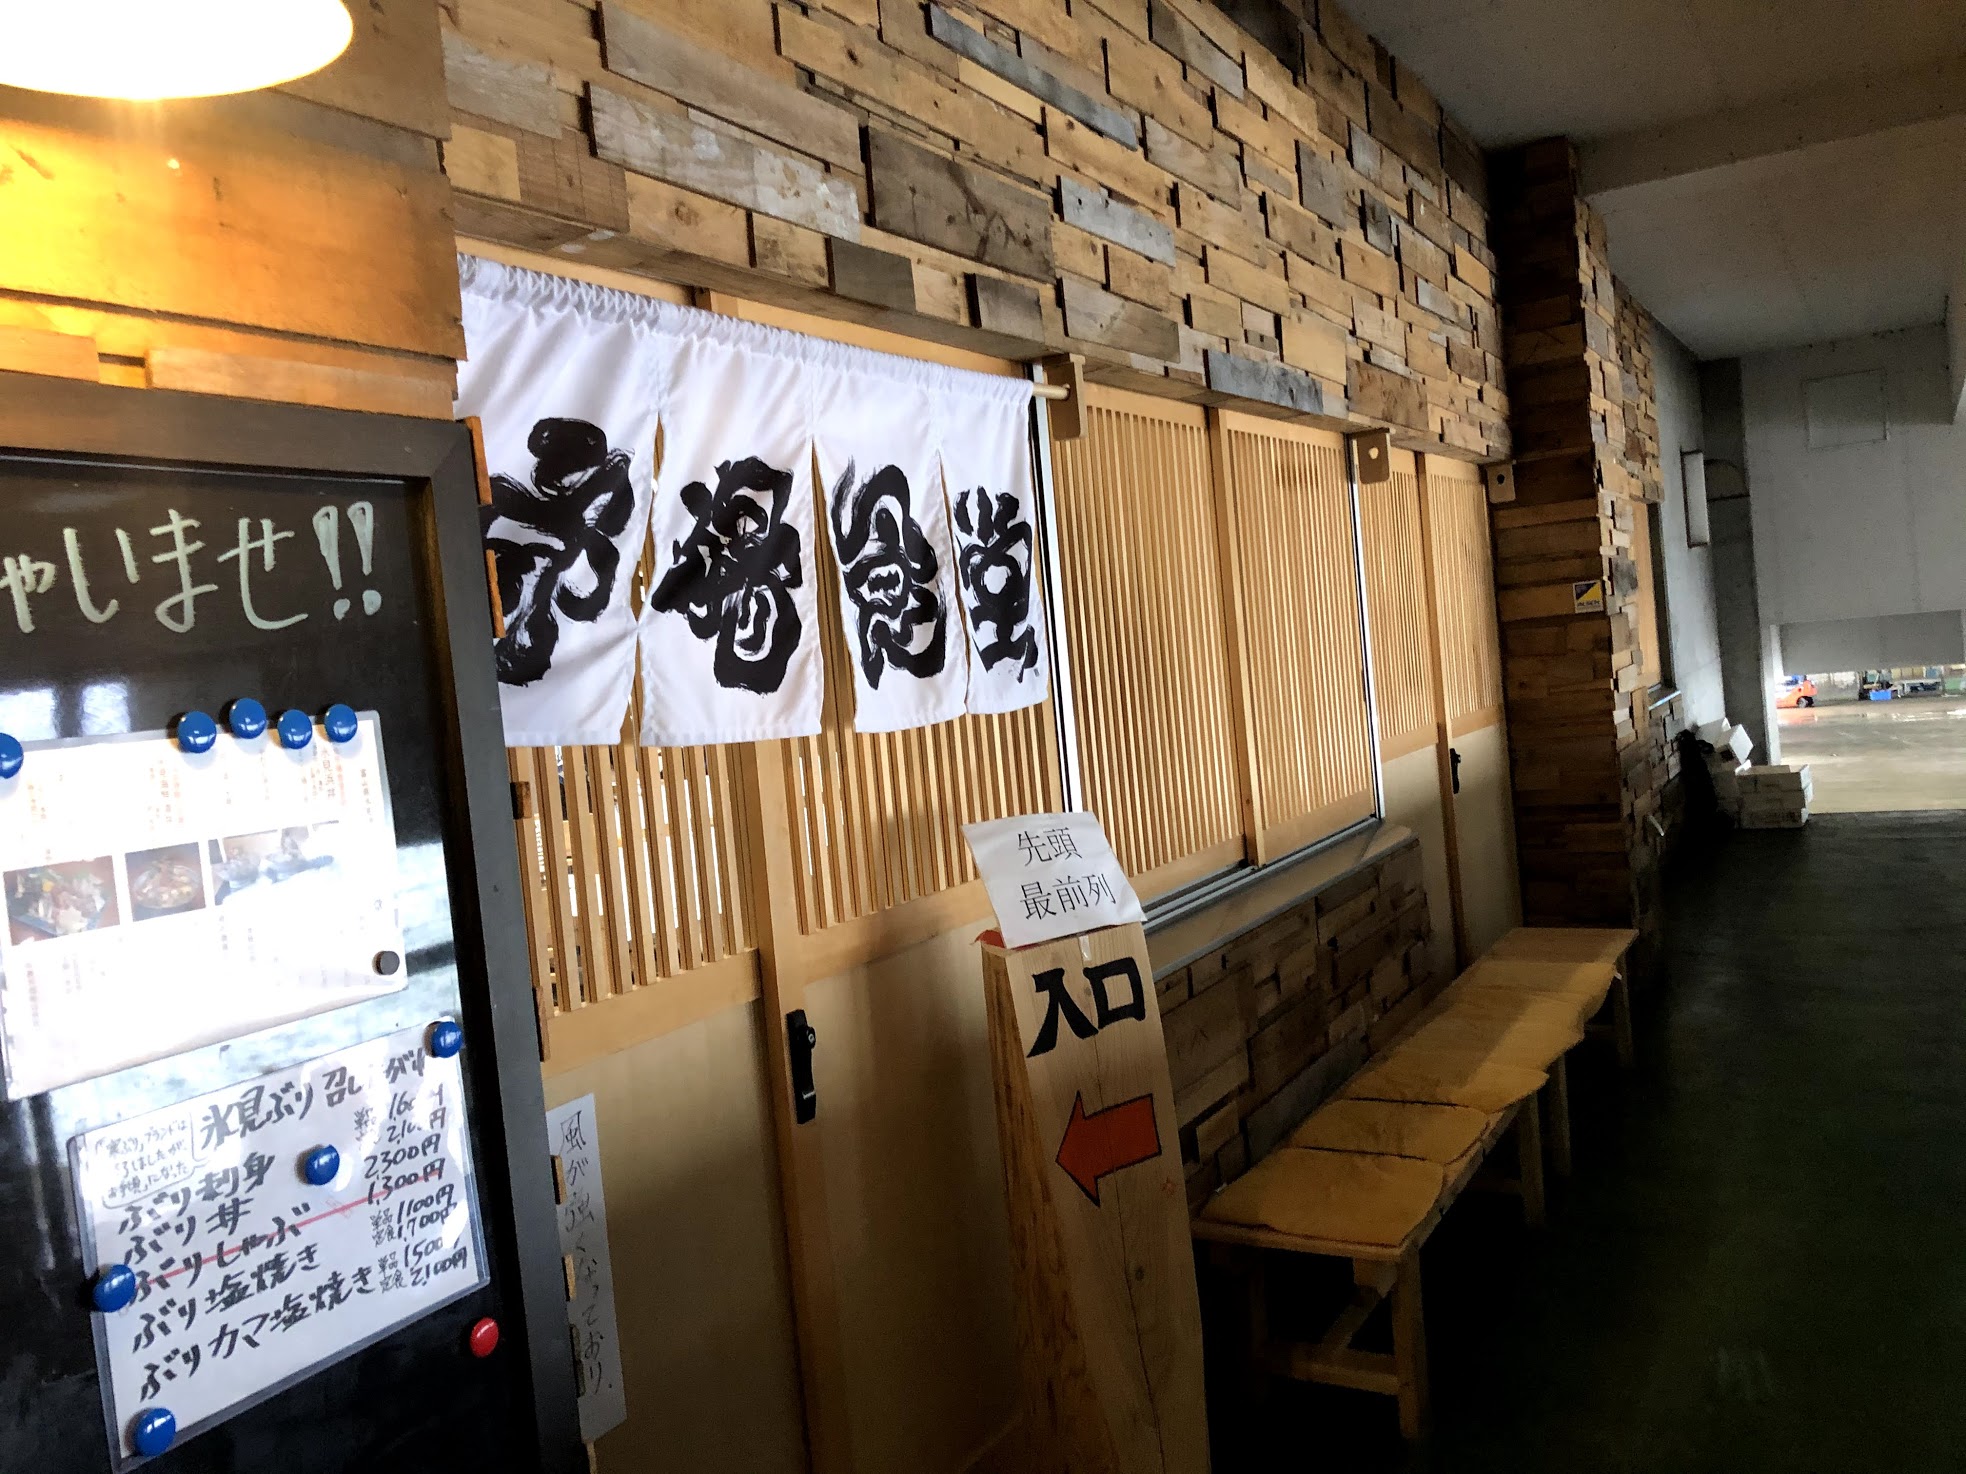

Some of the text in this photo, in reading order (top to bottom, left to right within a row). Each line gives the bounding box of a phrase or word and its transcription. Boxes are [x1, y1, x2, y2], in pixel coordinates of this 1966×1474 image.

[1017, 827, 1082, 867] 先頭
[1019, 873, 1116, 920] 最前列
[1026, 957, 1146, 1058] 入口
[132, 1243, 320, 1353] ぶり塩焼き
[140, 1266, 376, 1402] ぶりカマ塩焼き
